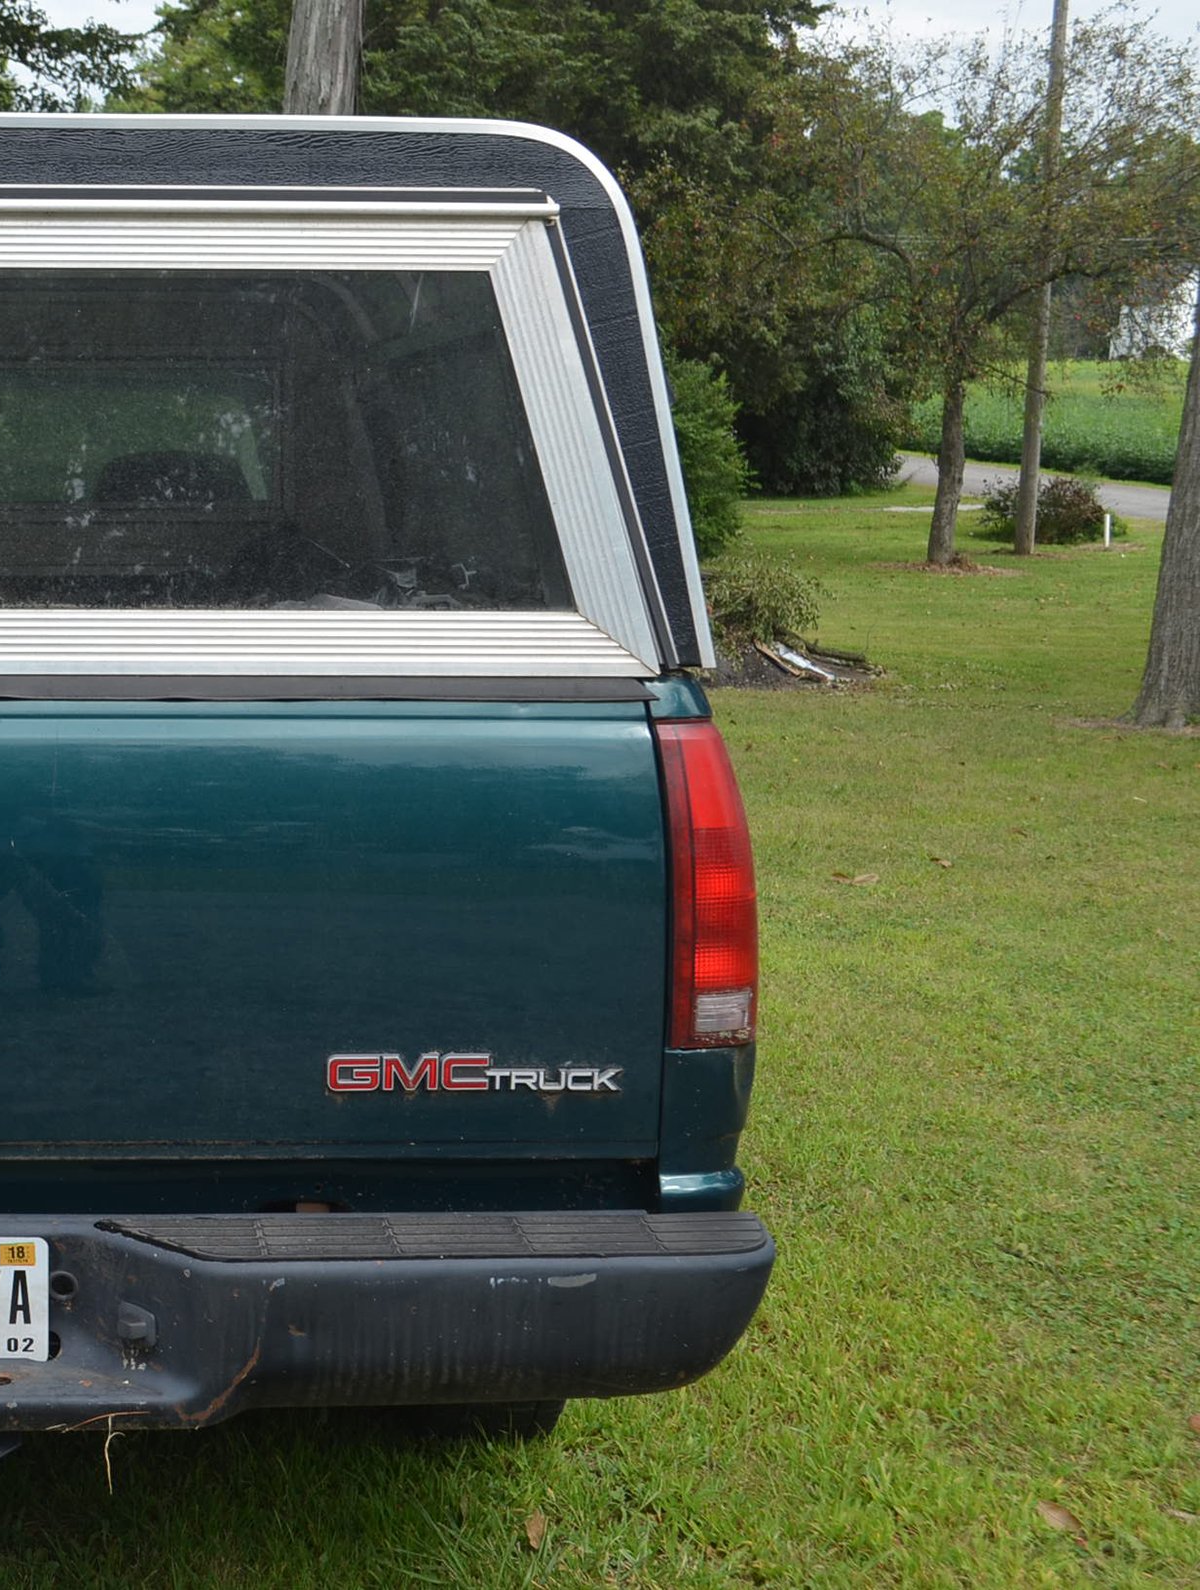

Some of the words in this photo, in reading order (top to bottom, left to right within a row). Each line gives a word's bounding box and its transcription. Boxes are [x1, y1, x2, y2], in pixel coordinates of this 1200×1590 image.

[326, 1052, 491, 1092] GMC
[485, 1068, 624, 1092] TRUCK
[7, 1245, 26, 1259] 18
[6, 1337, 35, 1353] 02
